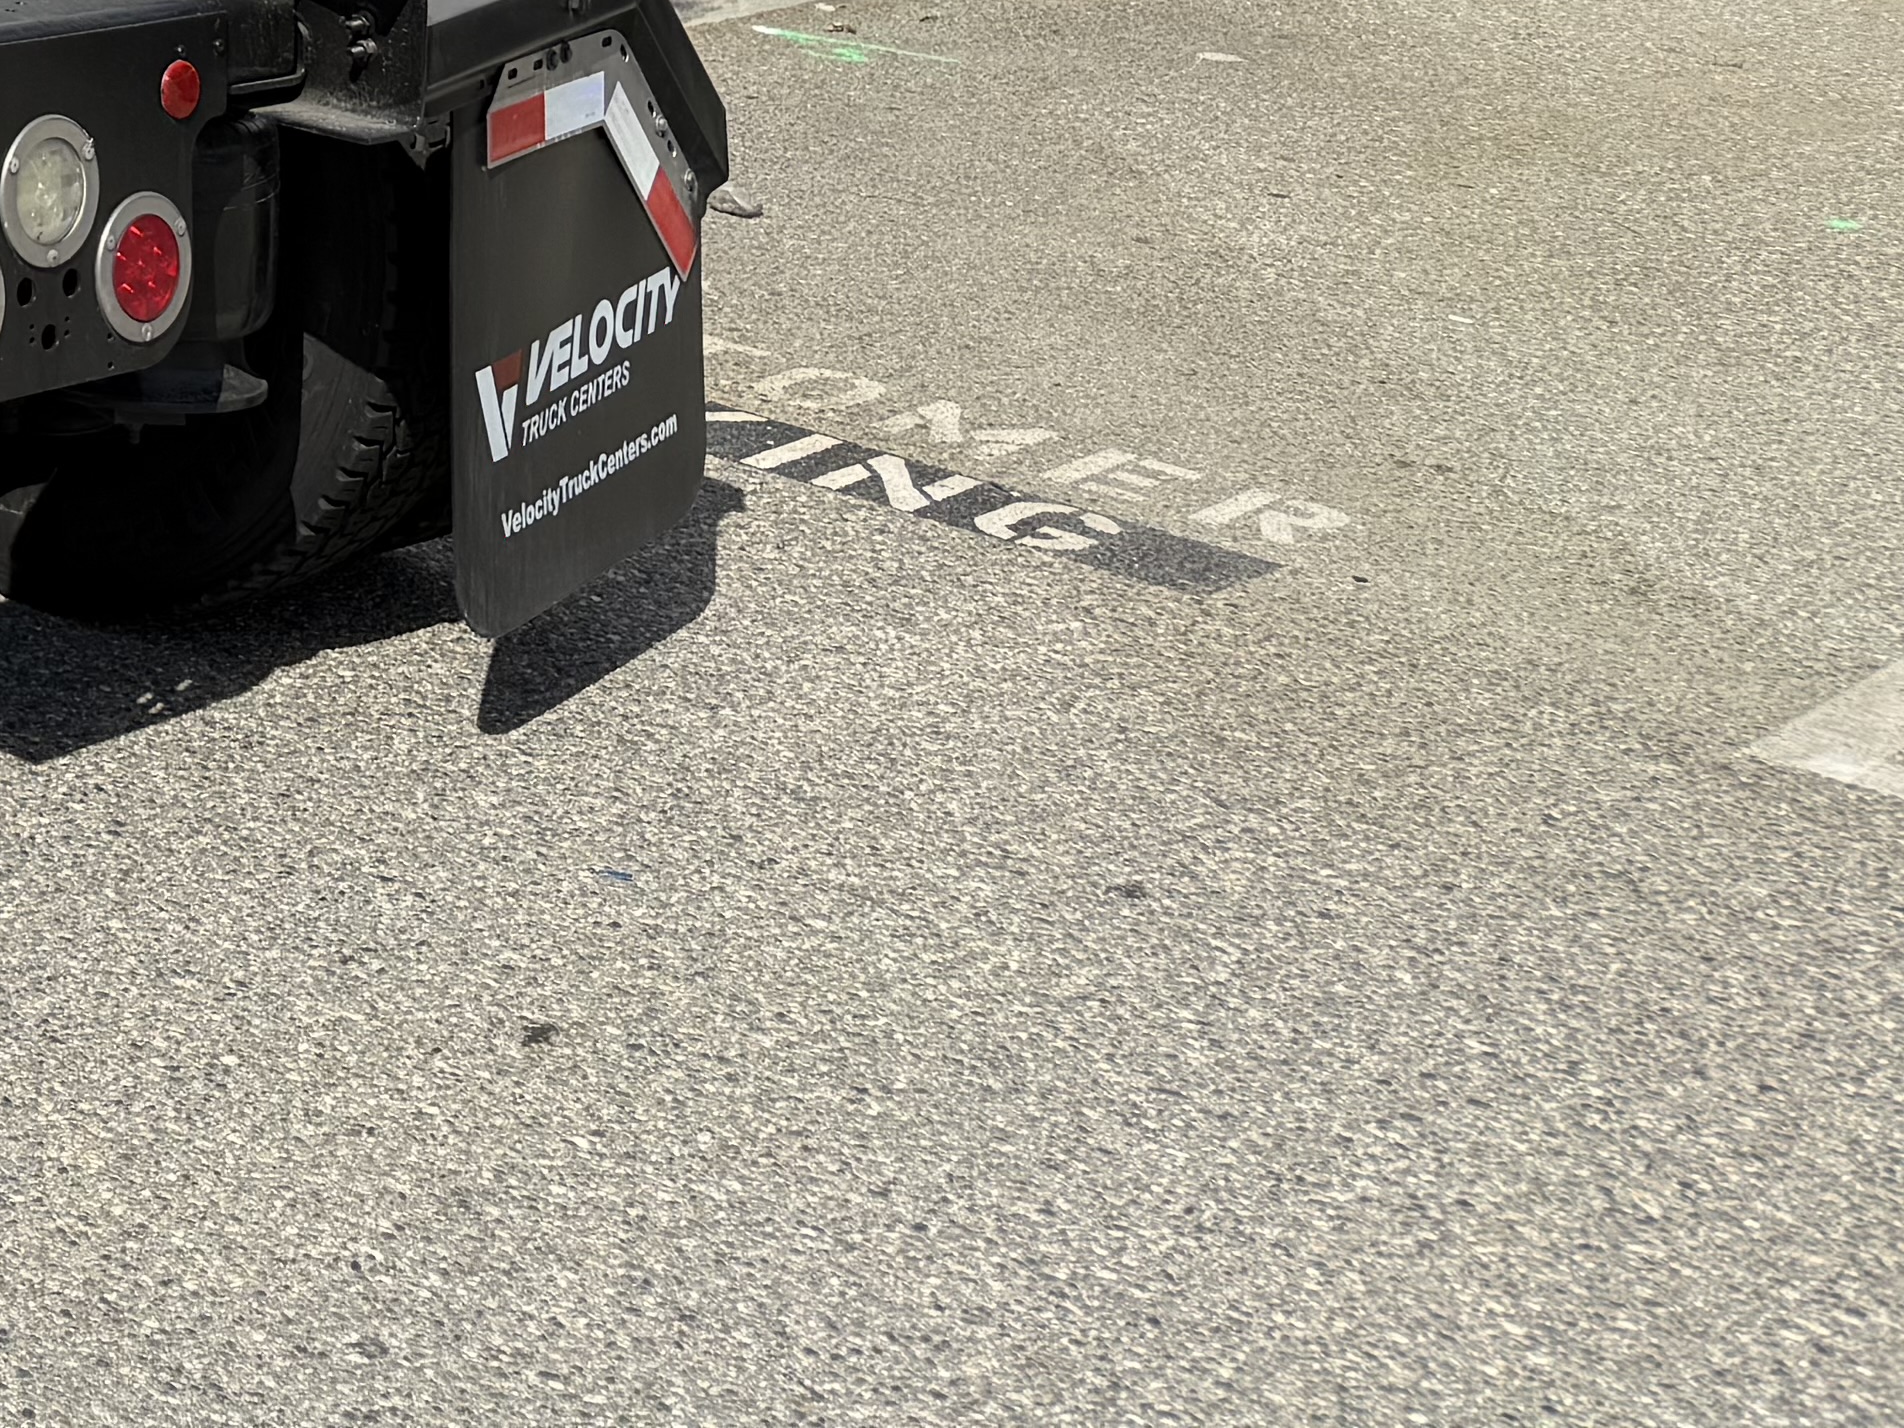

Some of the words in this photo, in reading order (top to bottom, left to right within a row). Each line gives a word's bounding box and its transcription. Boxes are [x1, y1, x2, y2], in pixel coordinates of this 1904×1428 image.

[525, 266, 681, 406] VELOCITY
[521, 396, 567, 447] TRUCK
[570, 360, 631, 417] CENTERS
[501, 413, 678, 538] VelocityTruckCenters.com
